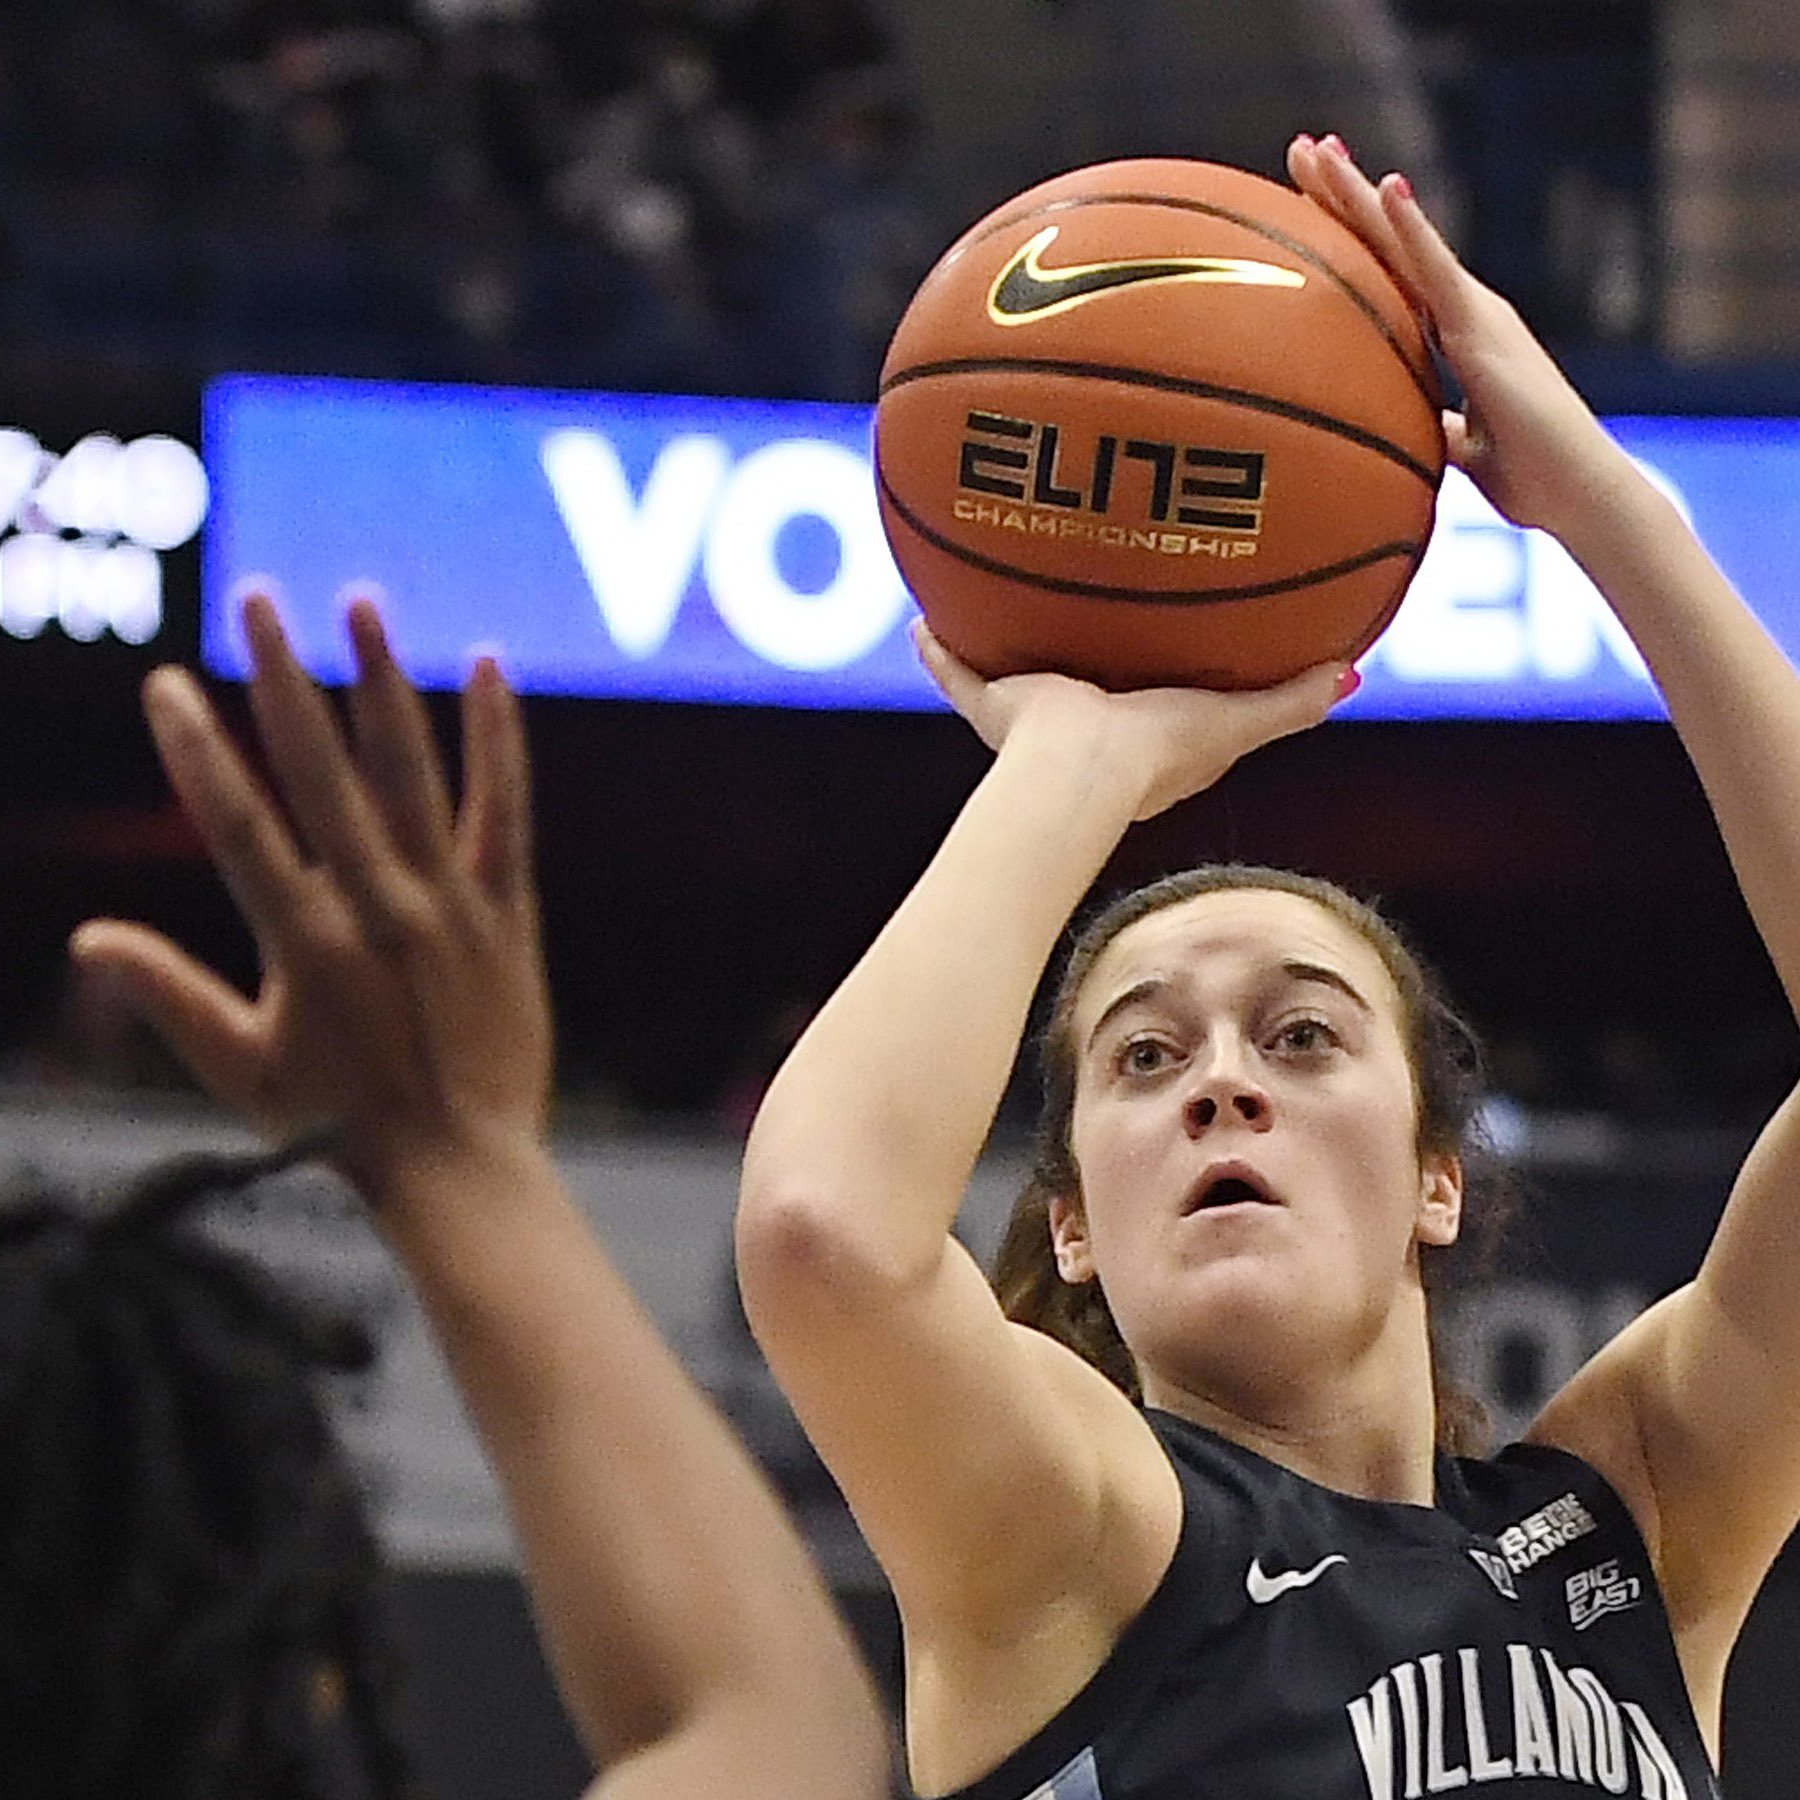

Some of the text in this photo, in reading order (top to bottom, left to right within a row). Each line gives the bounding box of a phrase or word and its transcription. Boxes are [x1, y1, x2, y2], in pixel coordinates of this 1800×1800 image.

[957, 408, 1267, 536] ELITE
[952, 500, 1258, 560] CHAMPIONSHIP
[1565, 1559, 1619, 1602] BIG
[1568, 1576, 1640, 1624] EAST
